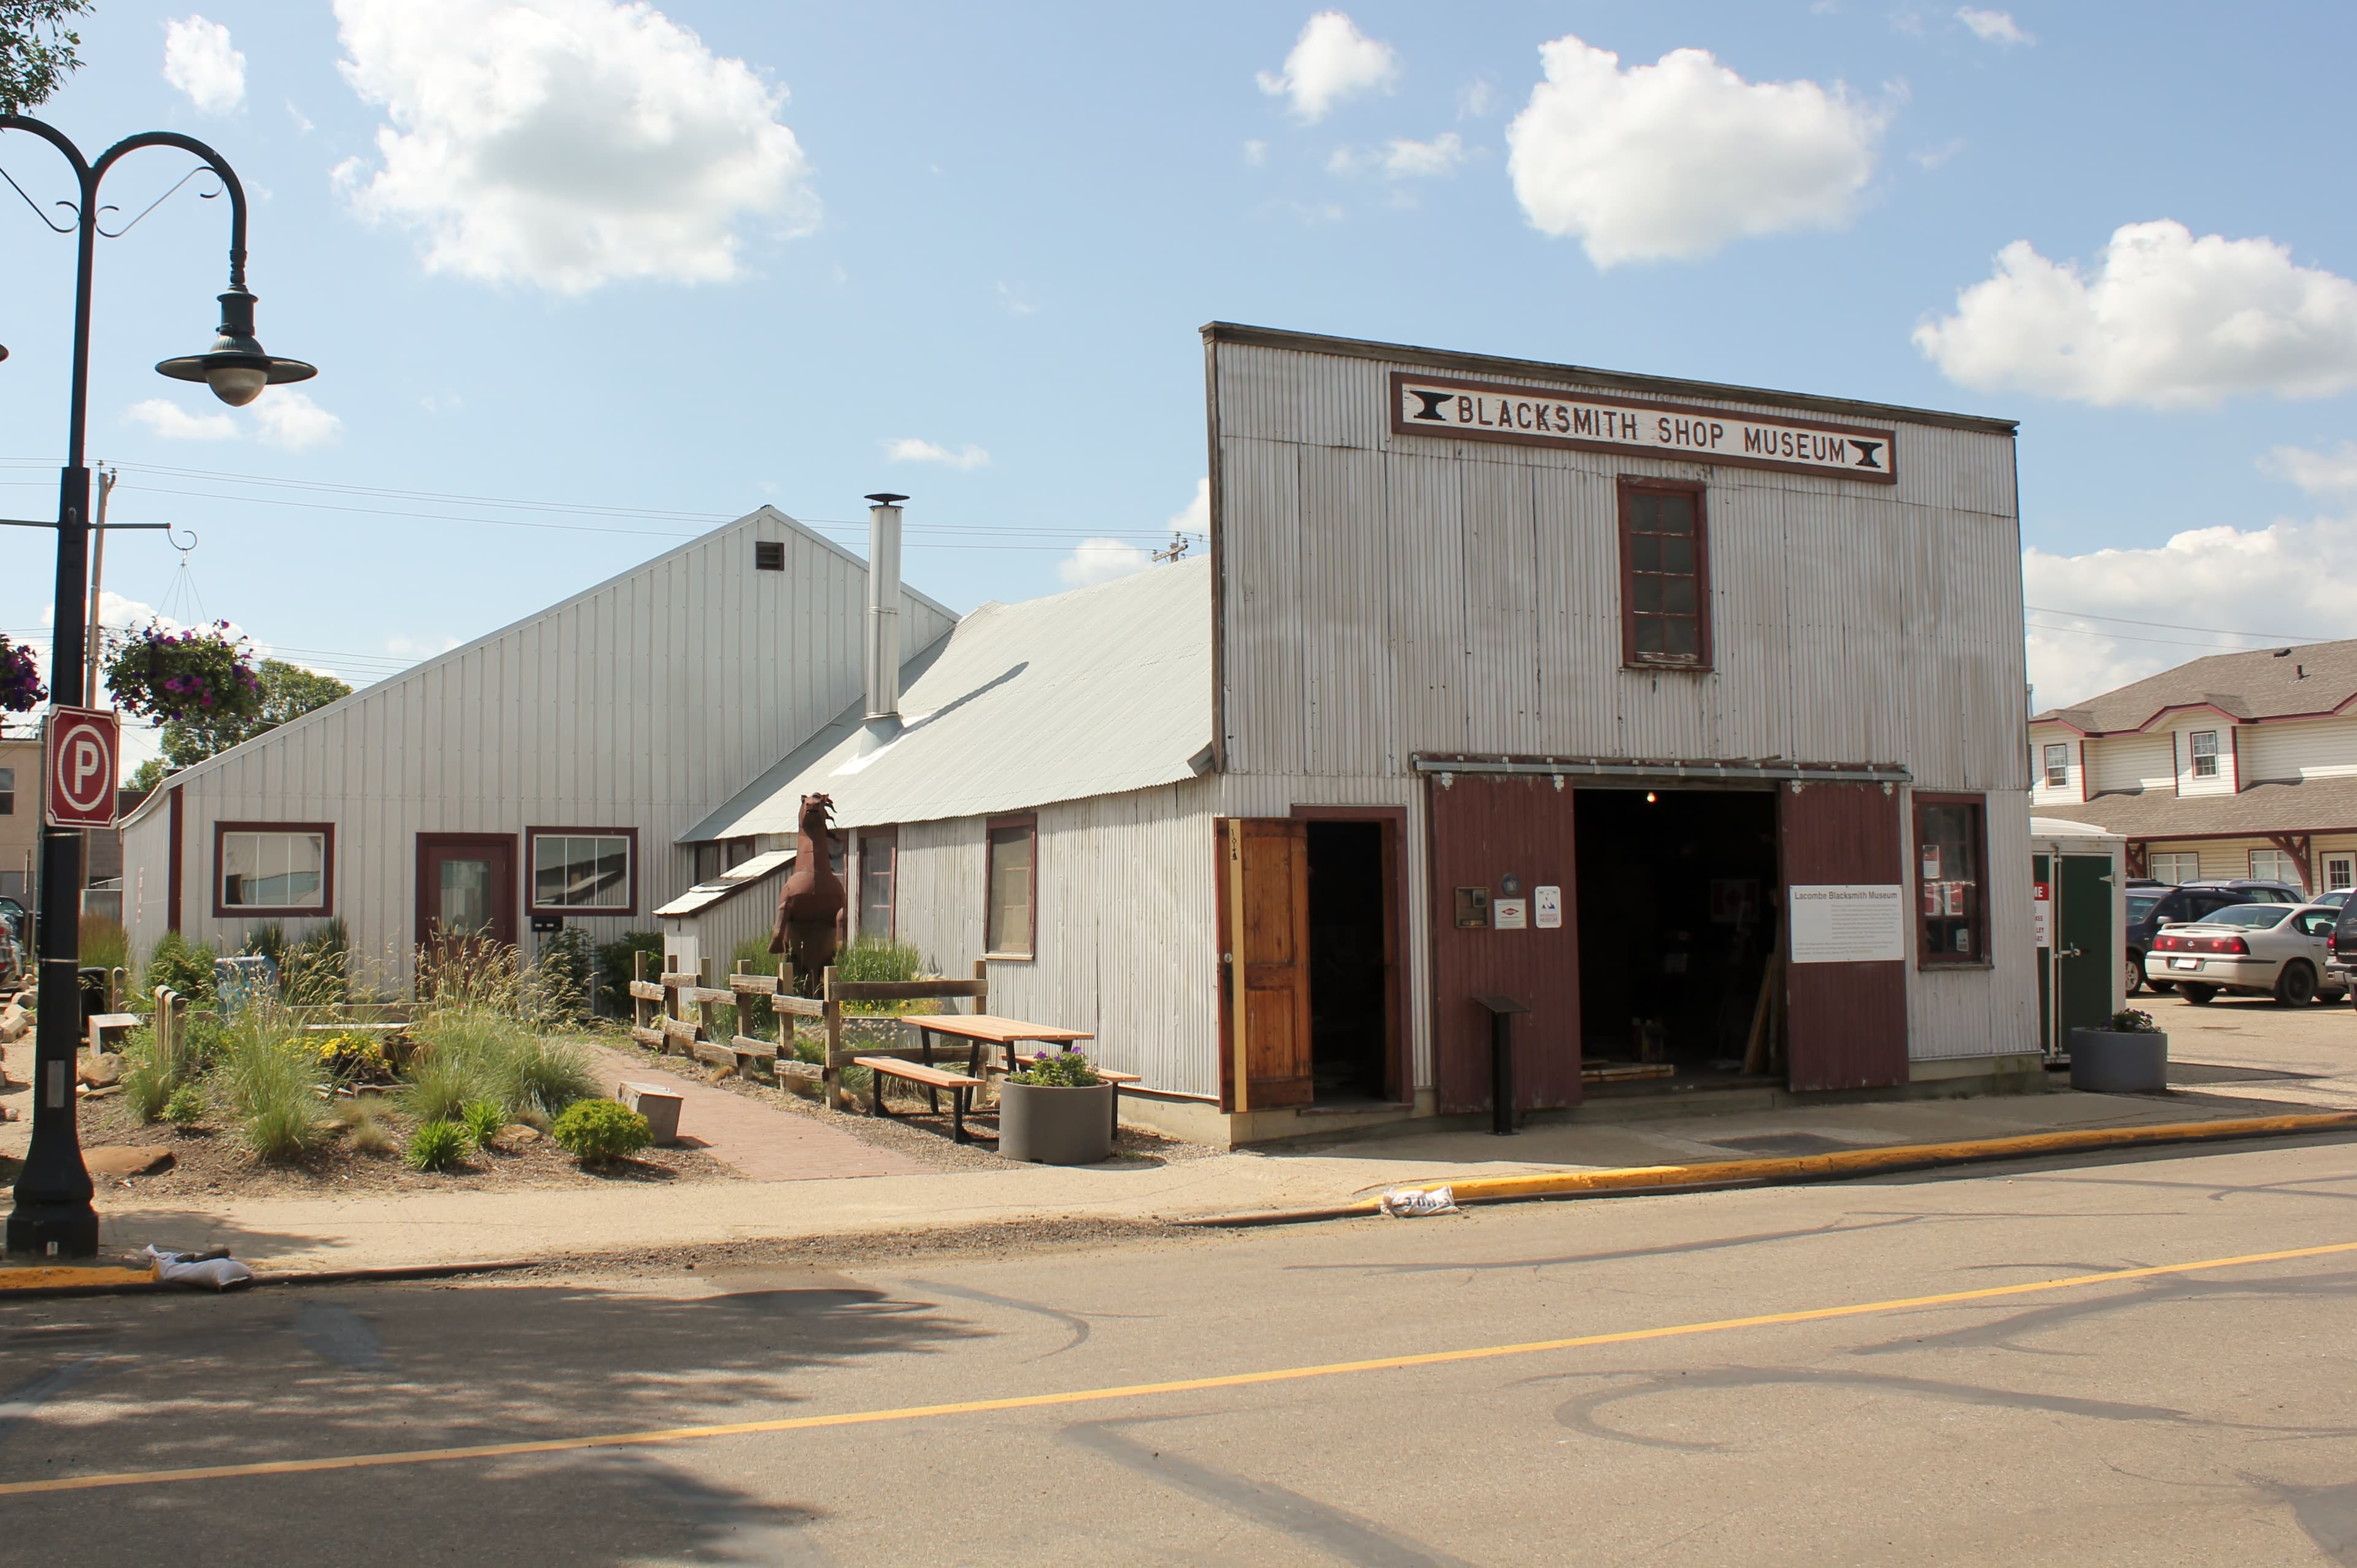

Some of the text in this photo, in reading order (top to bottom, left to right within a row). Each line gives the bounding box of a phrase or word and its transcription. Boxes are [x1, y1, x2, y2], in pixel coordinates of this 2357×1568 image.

[1458, 395, 1845, 463] BLACKSMITH SHOP MUSEUM
[74, 740, 99, 794] P
[1794, 891, 1827, 900] Lacombe
[1829, 891, 1867, 900] Blacksmith
